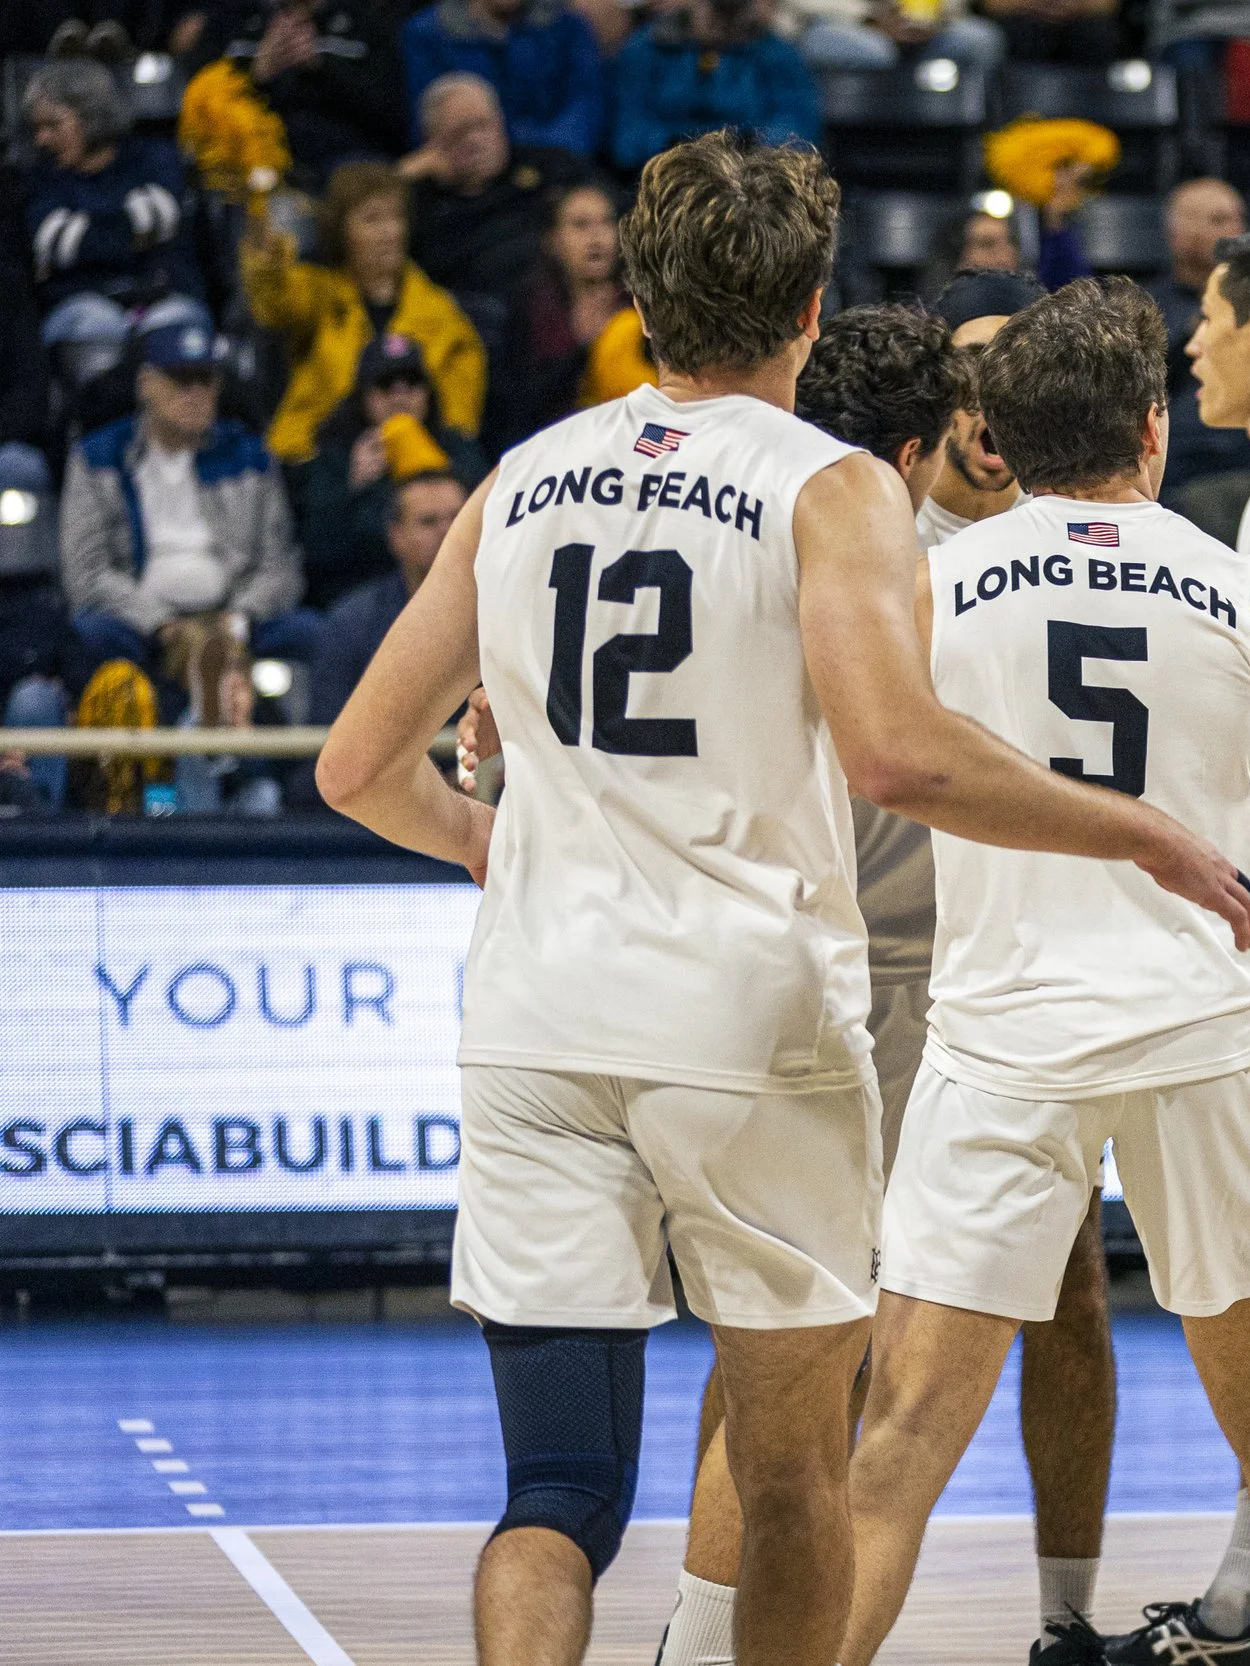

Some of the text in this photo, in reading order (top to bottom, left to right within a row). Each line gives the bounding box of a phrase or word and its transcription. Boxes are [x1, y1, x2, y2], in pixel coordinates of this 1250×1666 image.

[505, 466, 764, 541] LONG BEACH
[954, 554, 1238, 629] LONG BEACH
[546, 542, 699, 757] 12
[1047, 619, 1150, 799] 5
[93, 960, 396, 1030] YOUR
